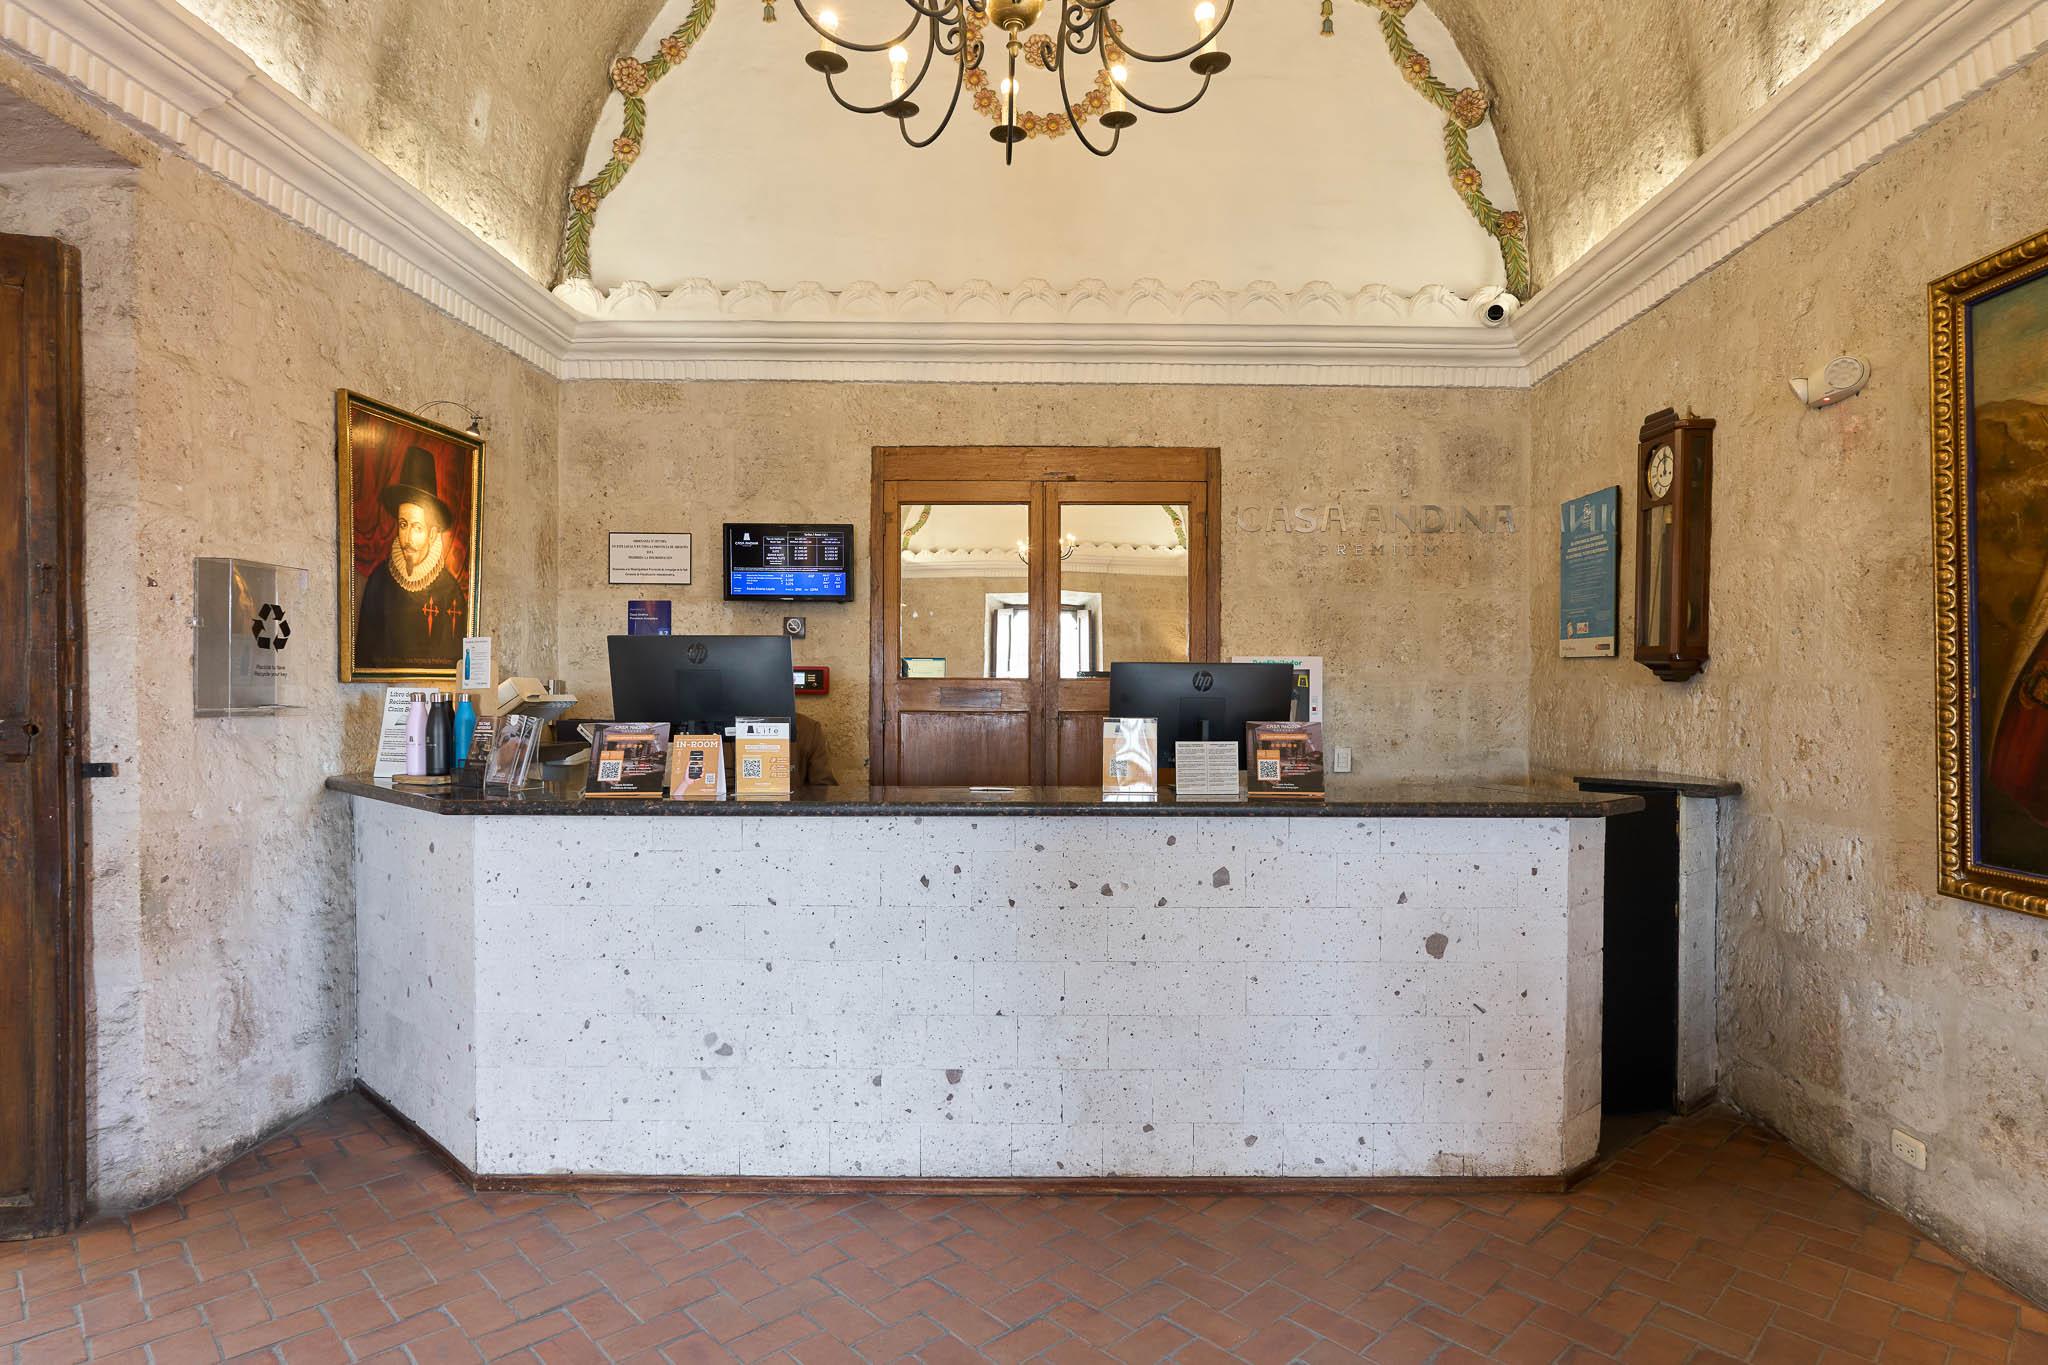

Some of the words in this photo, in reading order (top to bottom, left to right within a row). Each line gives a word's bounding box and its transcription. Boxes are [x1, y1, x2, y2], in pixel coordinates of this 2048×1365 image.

[1238, 504, 1347, 534] CASA
[1360, 504, 1517, 534] ANDINA
[1320, 545, 1440, 556] PREMIUM
[688, 643, 707, 664] hp
[1193, 671, 1213, 692] hp
[756, 726, 779, 734] Life
